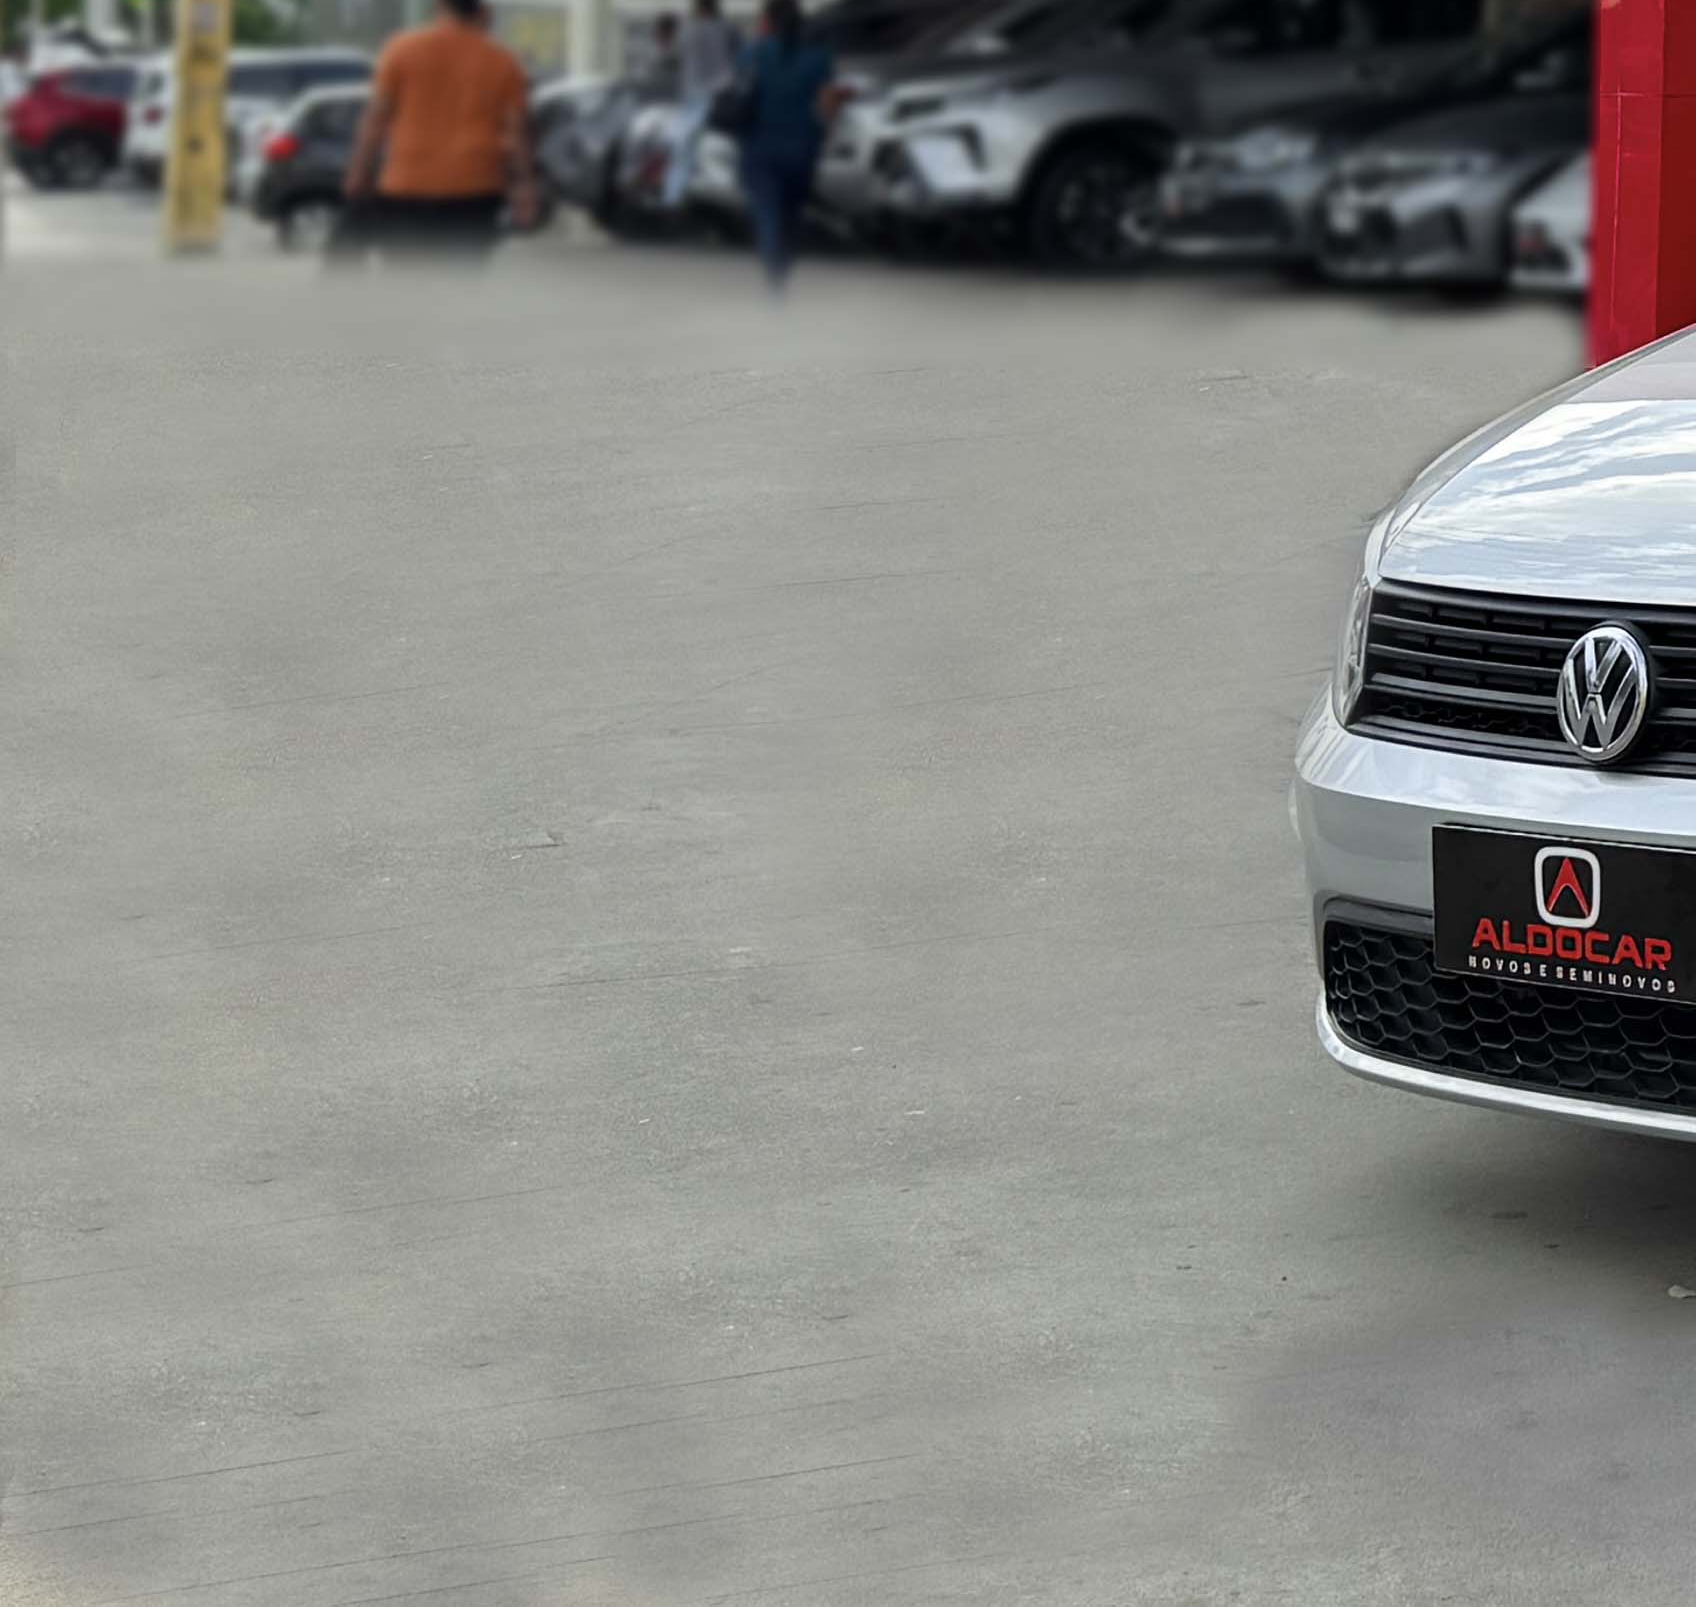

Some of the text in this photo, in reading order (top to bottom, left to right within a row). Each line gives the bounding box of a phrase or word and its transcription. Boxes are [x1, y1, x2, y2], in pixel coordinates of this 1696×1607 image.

[1471, 917, 1673, 971] ALDOCAR
[1468, 954, 1676, 994] NOVOS E SEMINOVOS
